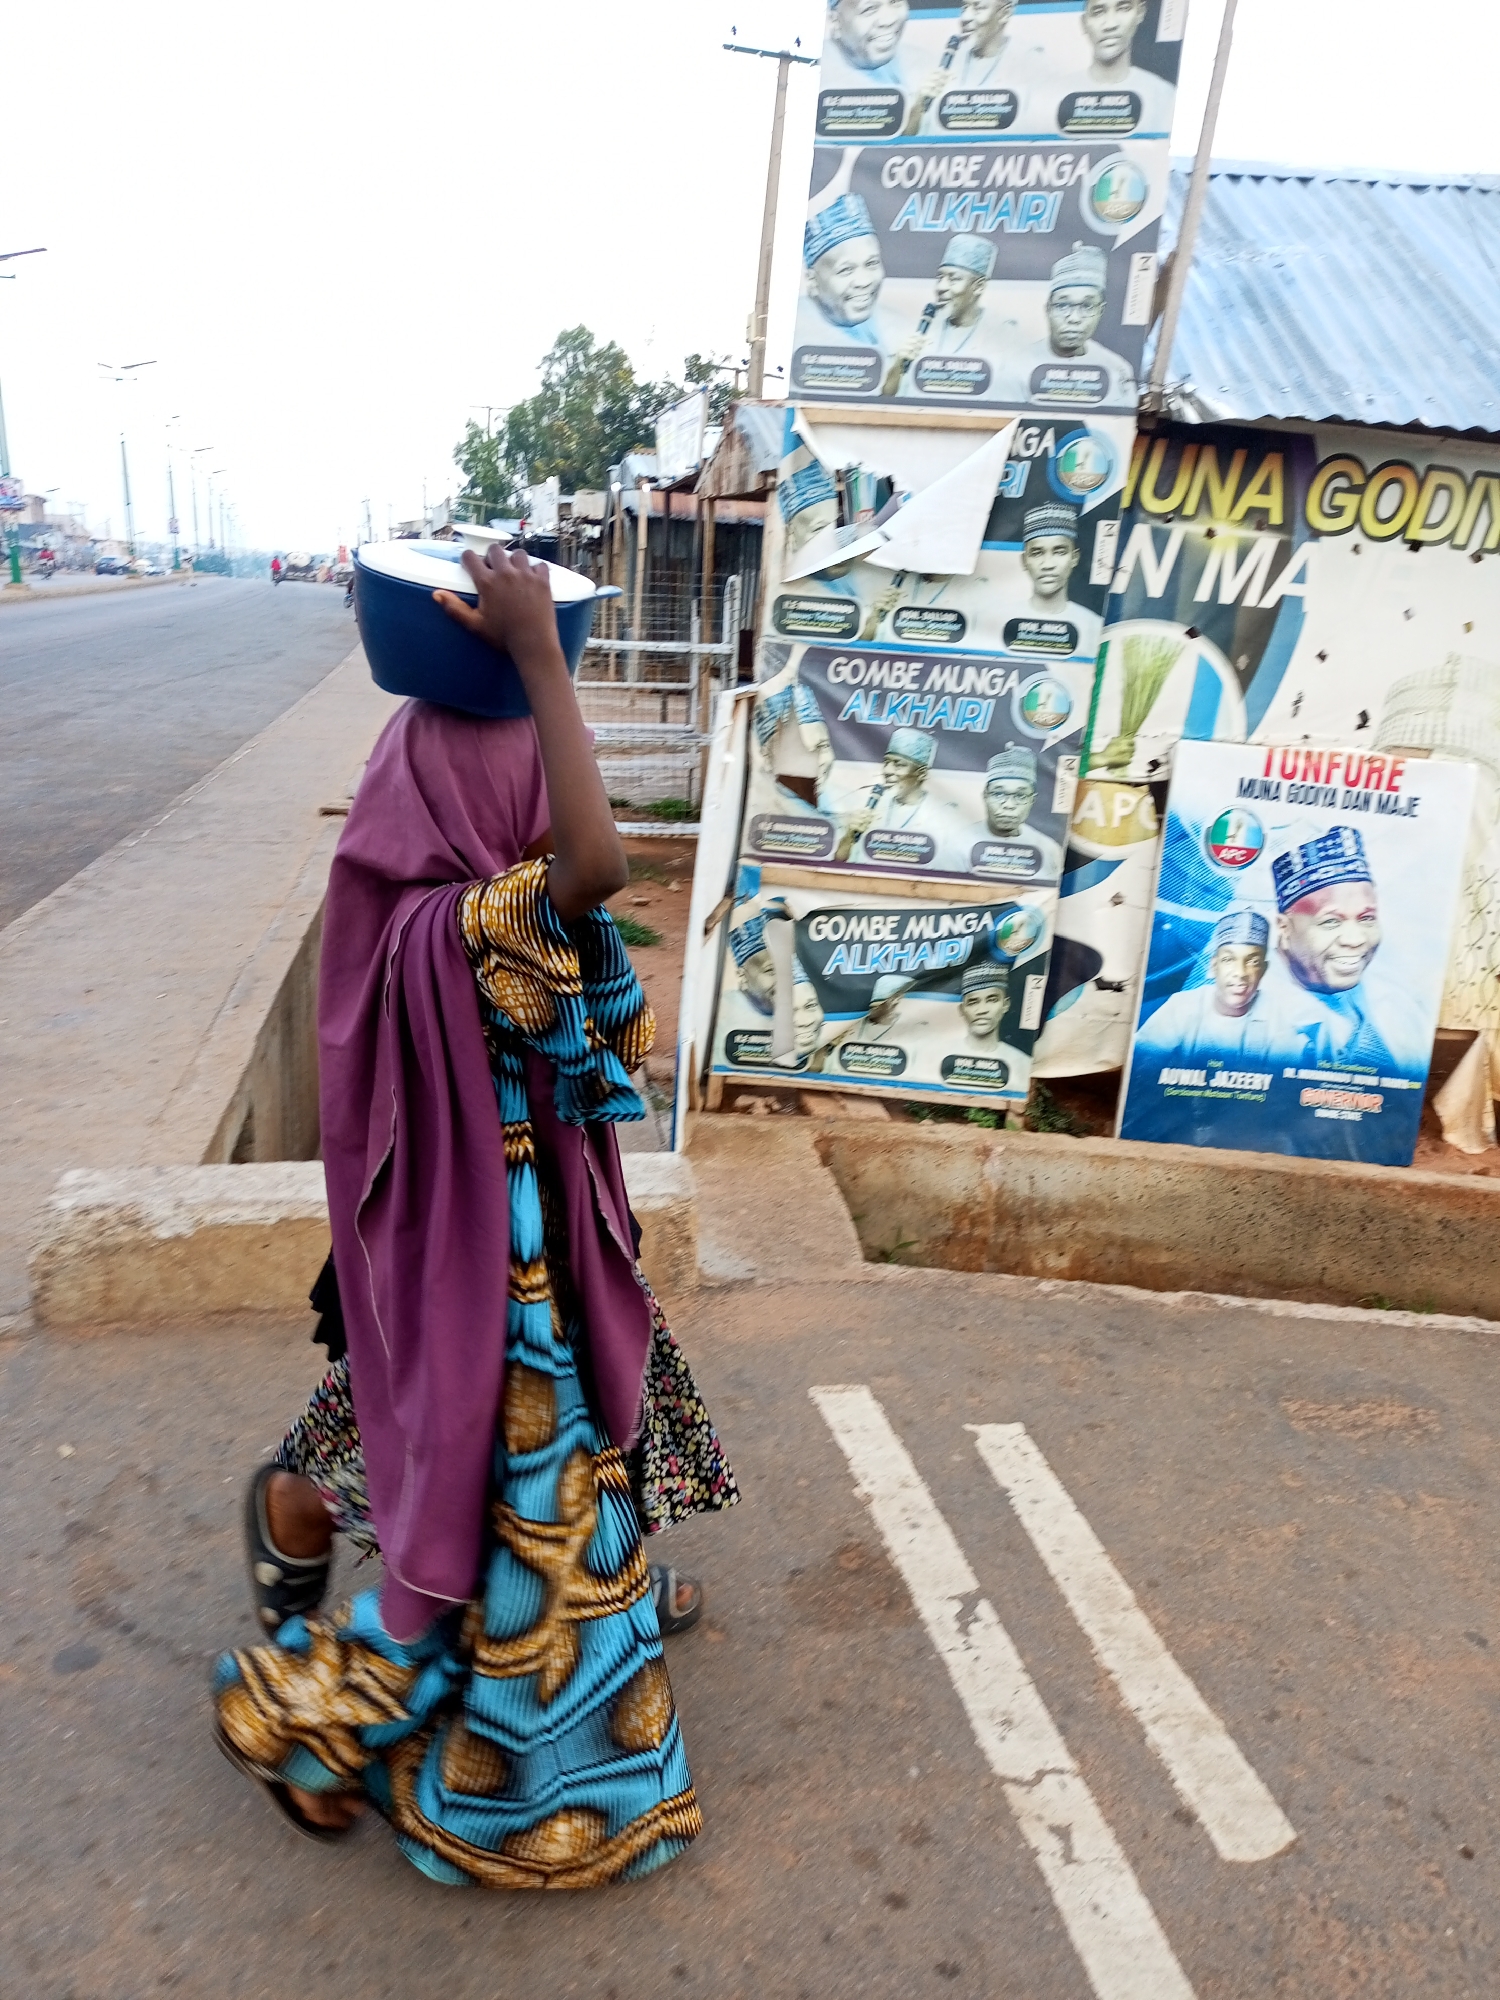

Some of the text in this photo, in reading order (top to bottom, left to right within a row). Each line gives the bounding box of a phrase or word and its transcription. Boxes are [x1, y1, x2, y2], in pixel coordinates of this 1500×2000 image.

[881, 153, 1090, 189] GOMBE MUNGA
[827, 656, 1020, 697] GOMBE MUNGA
[1218, 847, 1248, 862] APC
[808, 910, 995, 942] GOMBE MUNGA
